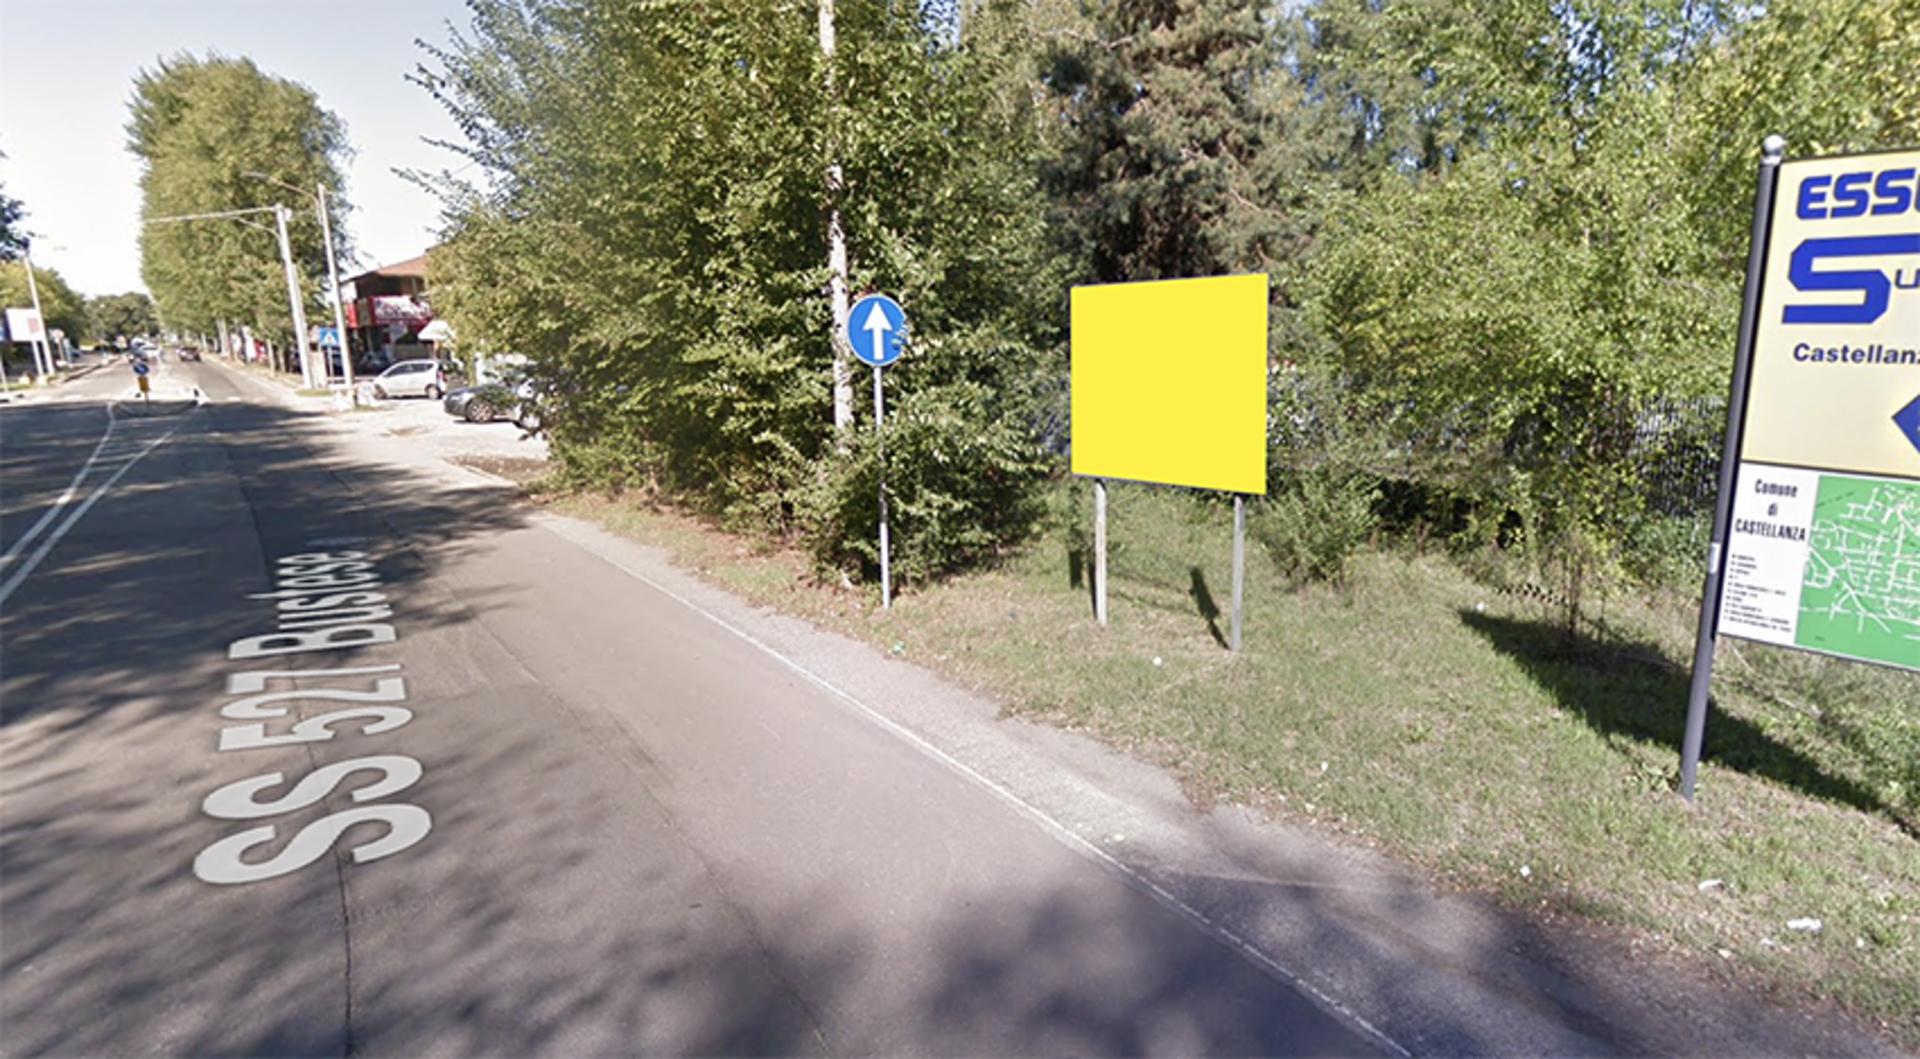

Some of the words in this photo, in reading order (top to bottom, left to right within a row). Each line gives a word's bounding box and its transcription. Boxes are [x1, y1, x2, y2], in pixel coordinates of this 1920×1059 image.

[1796, 168, 1920, 219] ESS
[1793, 343, 1920, 364] Castellan
[1755, 479, 1798, 498] Comune
[1767, 503, 1778, 516] di
[1735, 518, 1806, 541] CASTELLANZA
